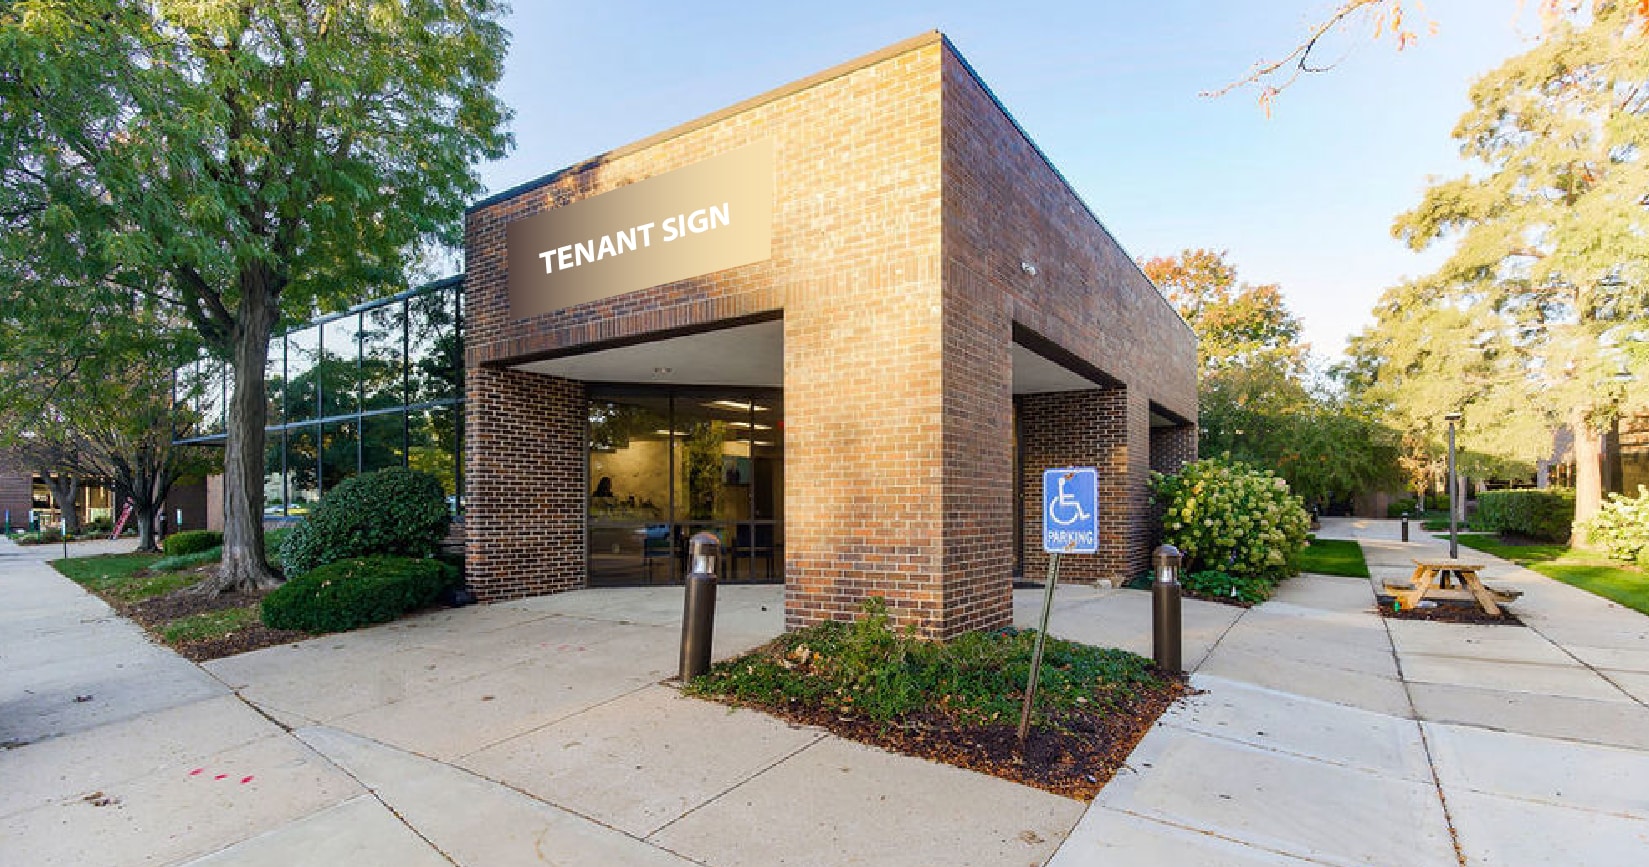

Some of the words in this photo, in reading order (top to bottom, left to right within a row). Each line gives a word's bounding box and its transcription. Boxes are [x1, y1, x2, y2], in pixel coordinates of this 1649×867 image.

[539, 222, 655, 275] TENANT
[662, 203, 730, 242] SIGN
[1048, 530, 1093, 545] PARKING
